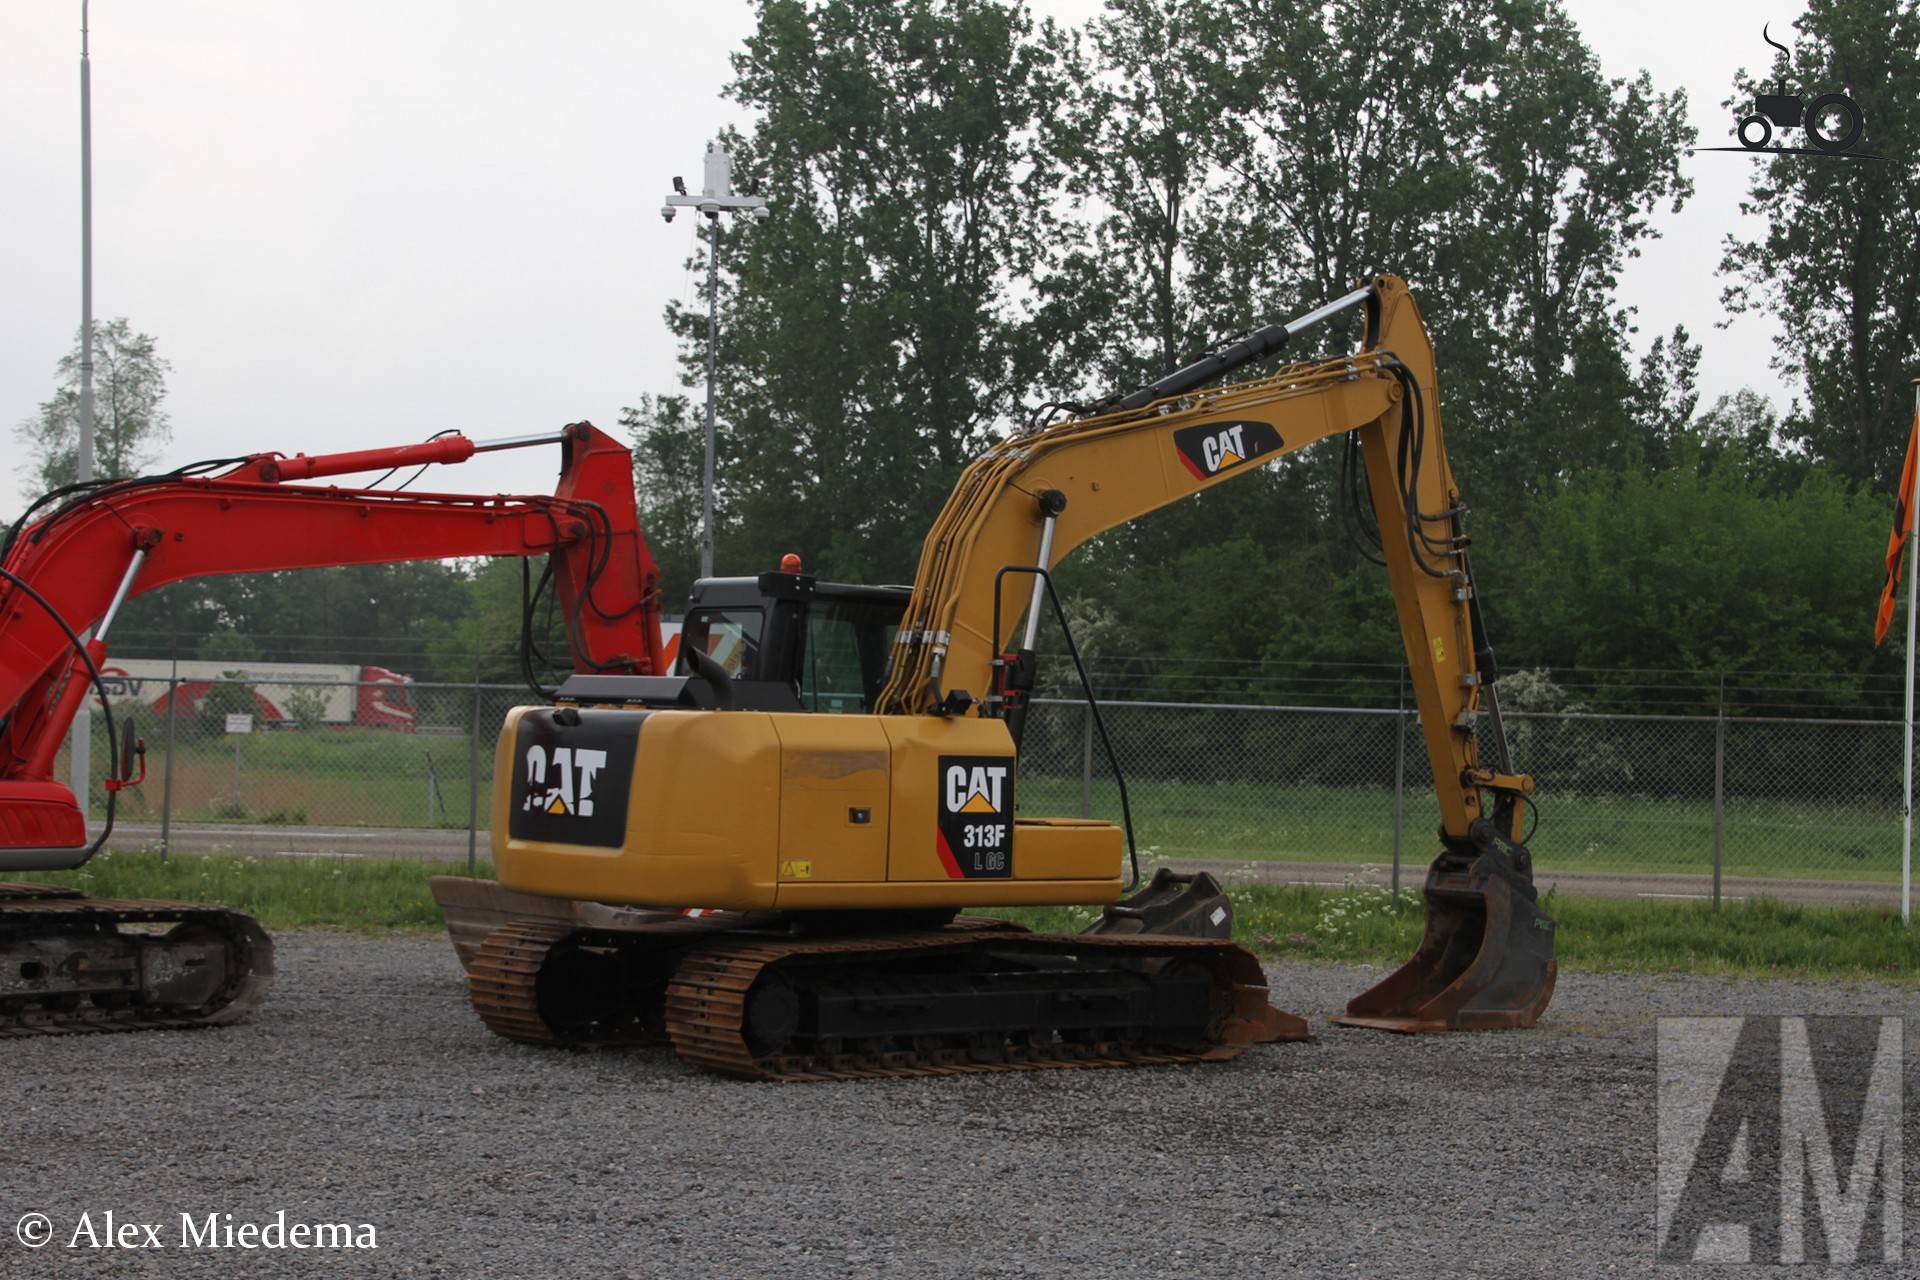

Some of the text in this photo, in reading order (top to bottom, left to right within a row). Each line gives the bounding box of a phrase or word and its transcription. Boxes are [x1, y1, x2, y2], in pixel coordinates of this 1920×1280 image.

[1202, 424, 1247, 473] CAT
[522, 745, 607, 817] CAT
[946, 765, 1007, 813] CAT
[963, 824, 1006, 848] 313F
[973, 851, 1005, 870] L GC
